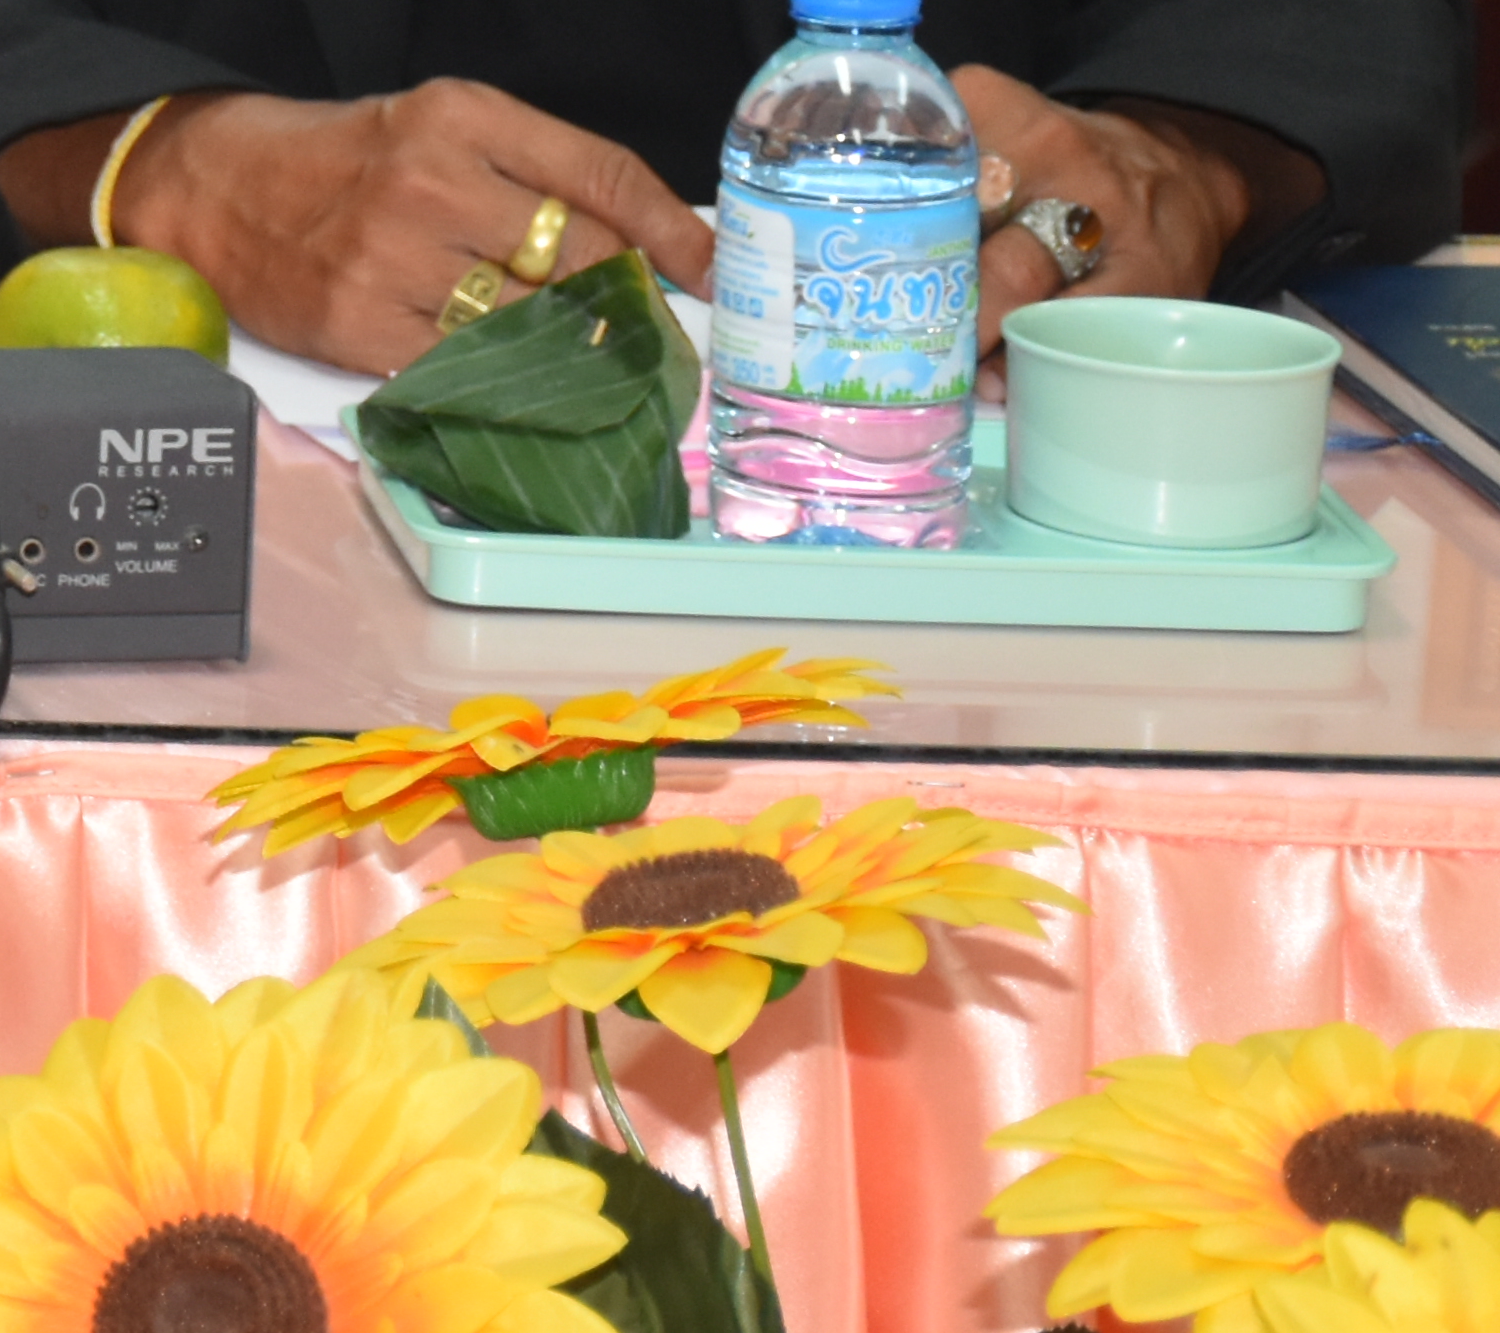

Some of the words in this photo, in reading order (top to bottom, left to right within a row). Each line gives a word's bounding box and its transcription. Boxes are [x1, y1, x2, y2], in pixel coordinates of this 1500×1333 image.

[827, 337, 902, 352] DRINKING
[99, 428, 235, 464] NPE
[98, 464, 234, 478] RESEARCH
[115, 541, 138, 552] MIN
[154, 541, 180, 551] MAX
[115, 559, 178, 574] VOLUME
[57, 573, 111, 587] PHONE
